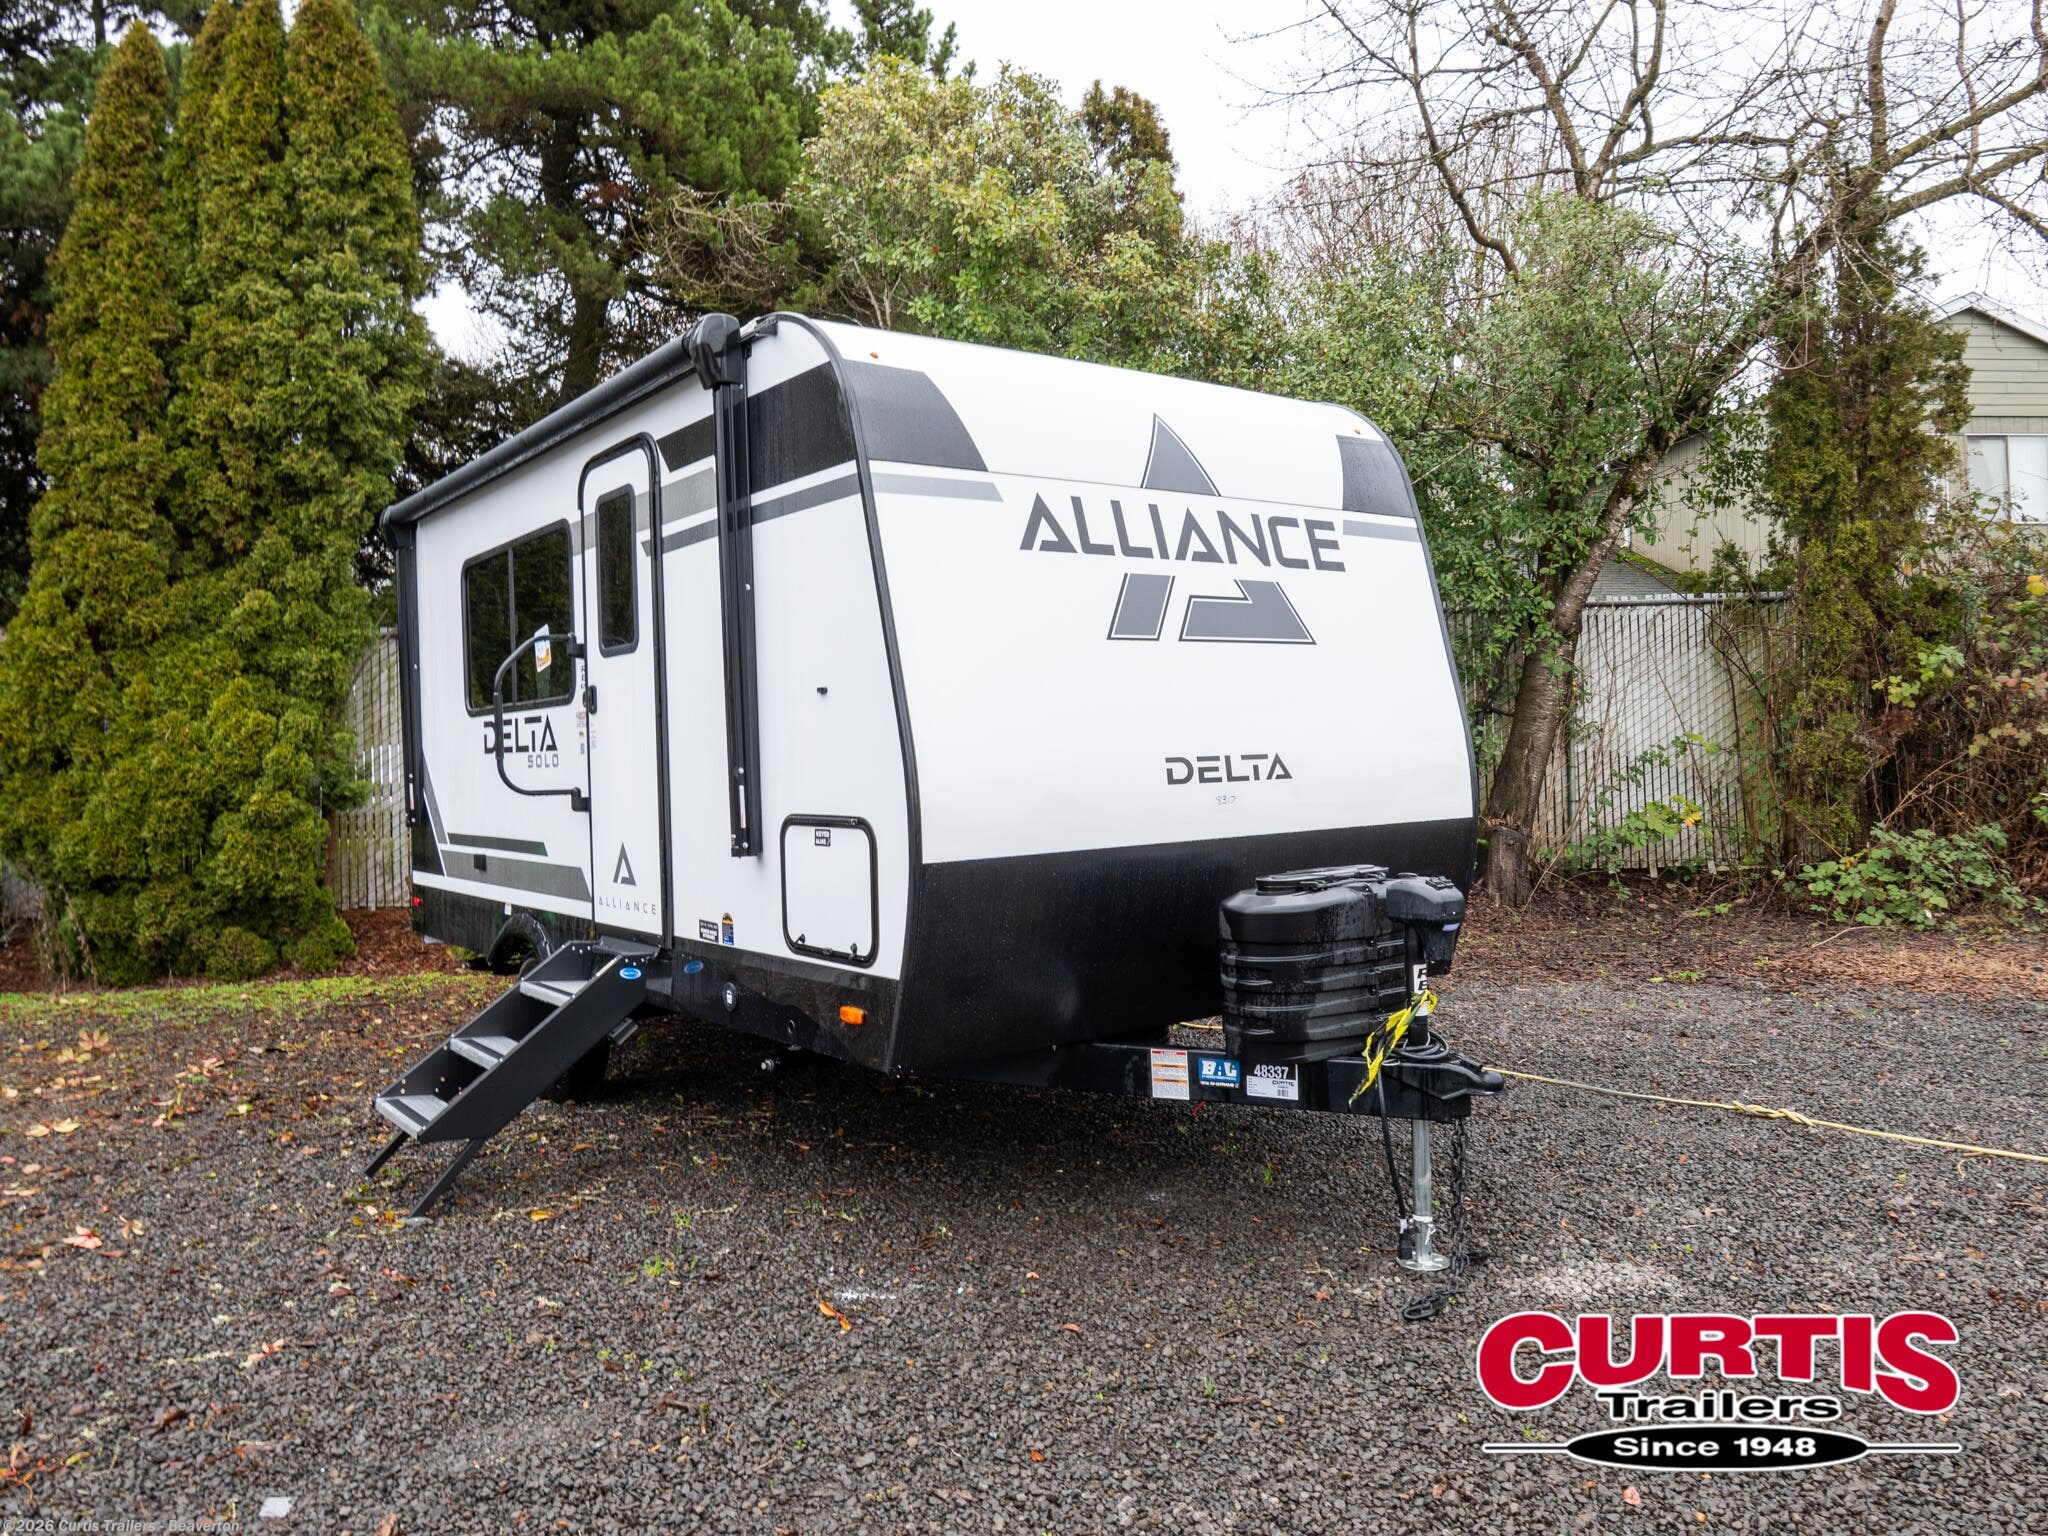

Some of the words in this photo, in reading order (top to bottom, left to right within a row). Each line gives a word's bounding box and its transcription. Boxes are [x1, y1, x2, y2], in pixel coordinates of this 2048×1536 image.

[1019, 492, 1346, 572] ALLIANCE
[483, 714, 558, 755] DELTA
[527, 753, 559, 768] SOLO
[1165, 753, 1293, 785] DELTA
[598, 896, 657, 915] ALLIANCE
[1253, 1064, 1289, 1080] 48337
